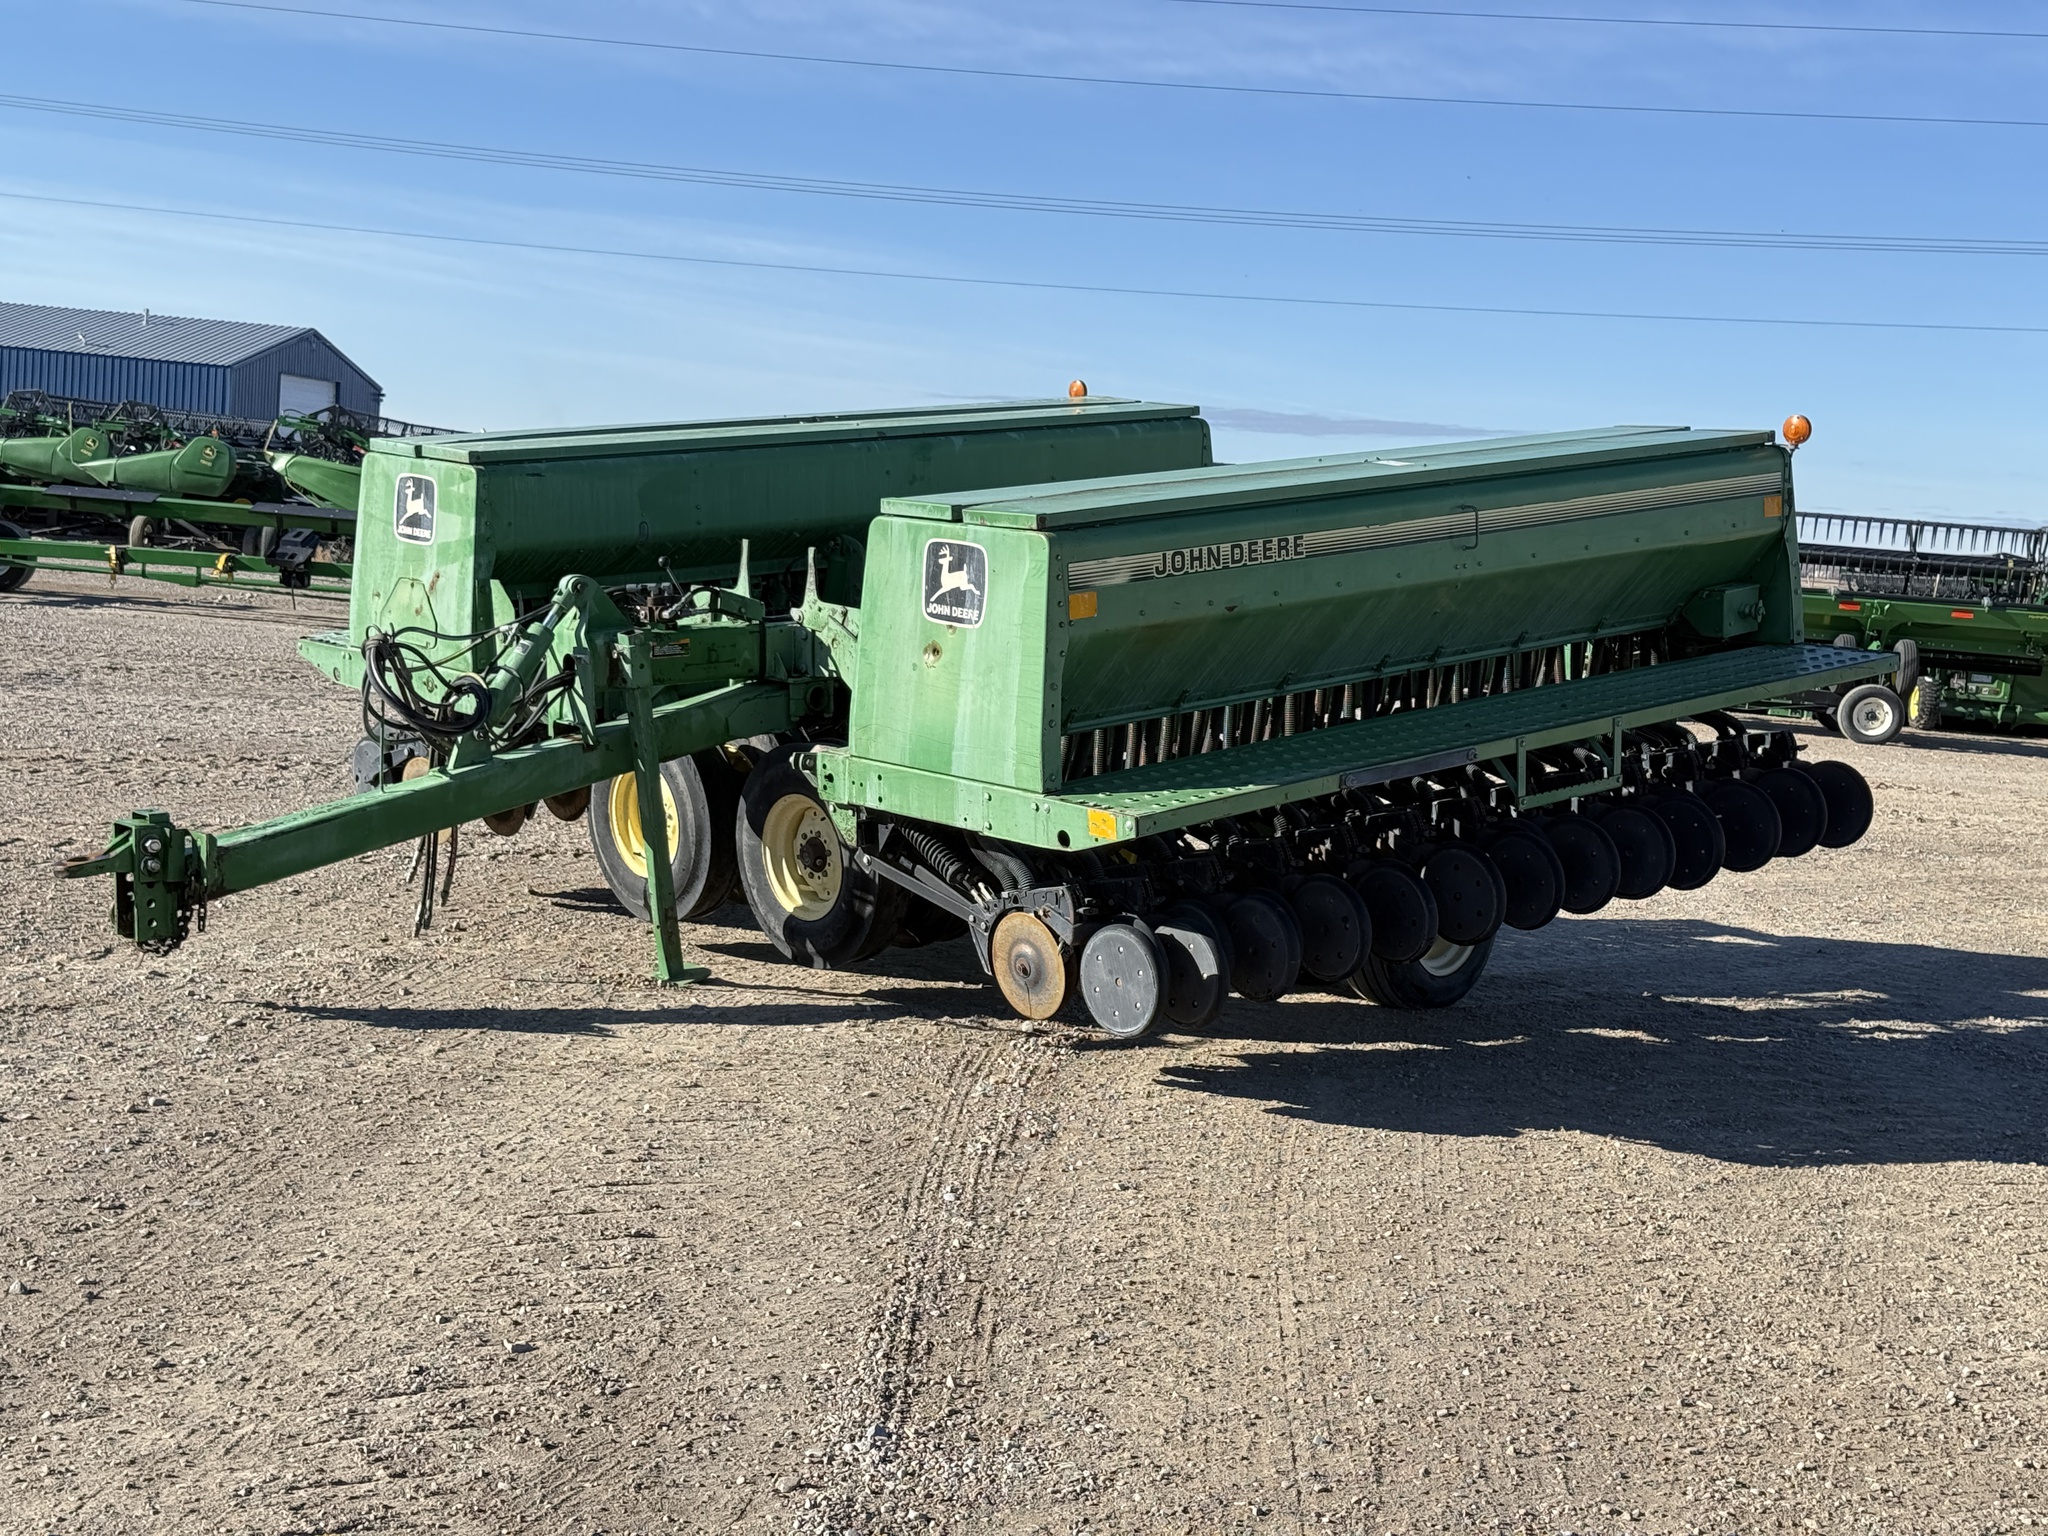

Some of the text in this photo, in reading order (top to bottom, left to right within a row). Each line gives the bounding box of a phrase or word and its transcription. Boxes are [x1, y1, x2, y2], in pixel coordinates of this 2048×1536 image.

[1154, 535, 1305, 578] JOHN DEERE
[926, 602, 980, 621] JOHN DEERE
